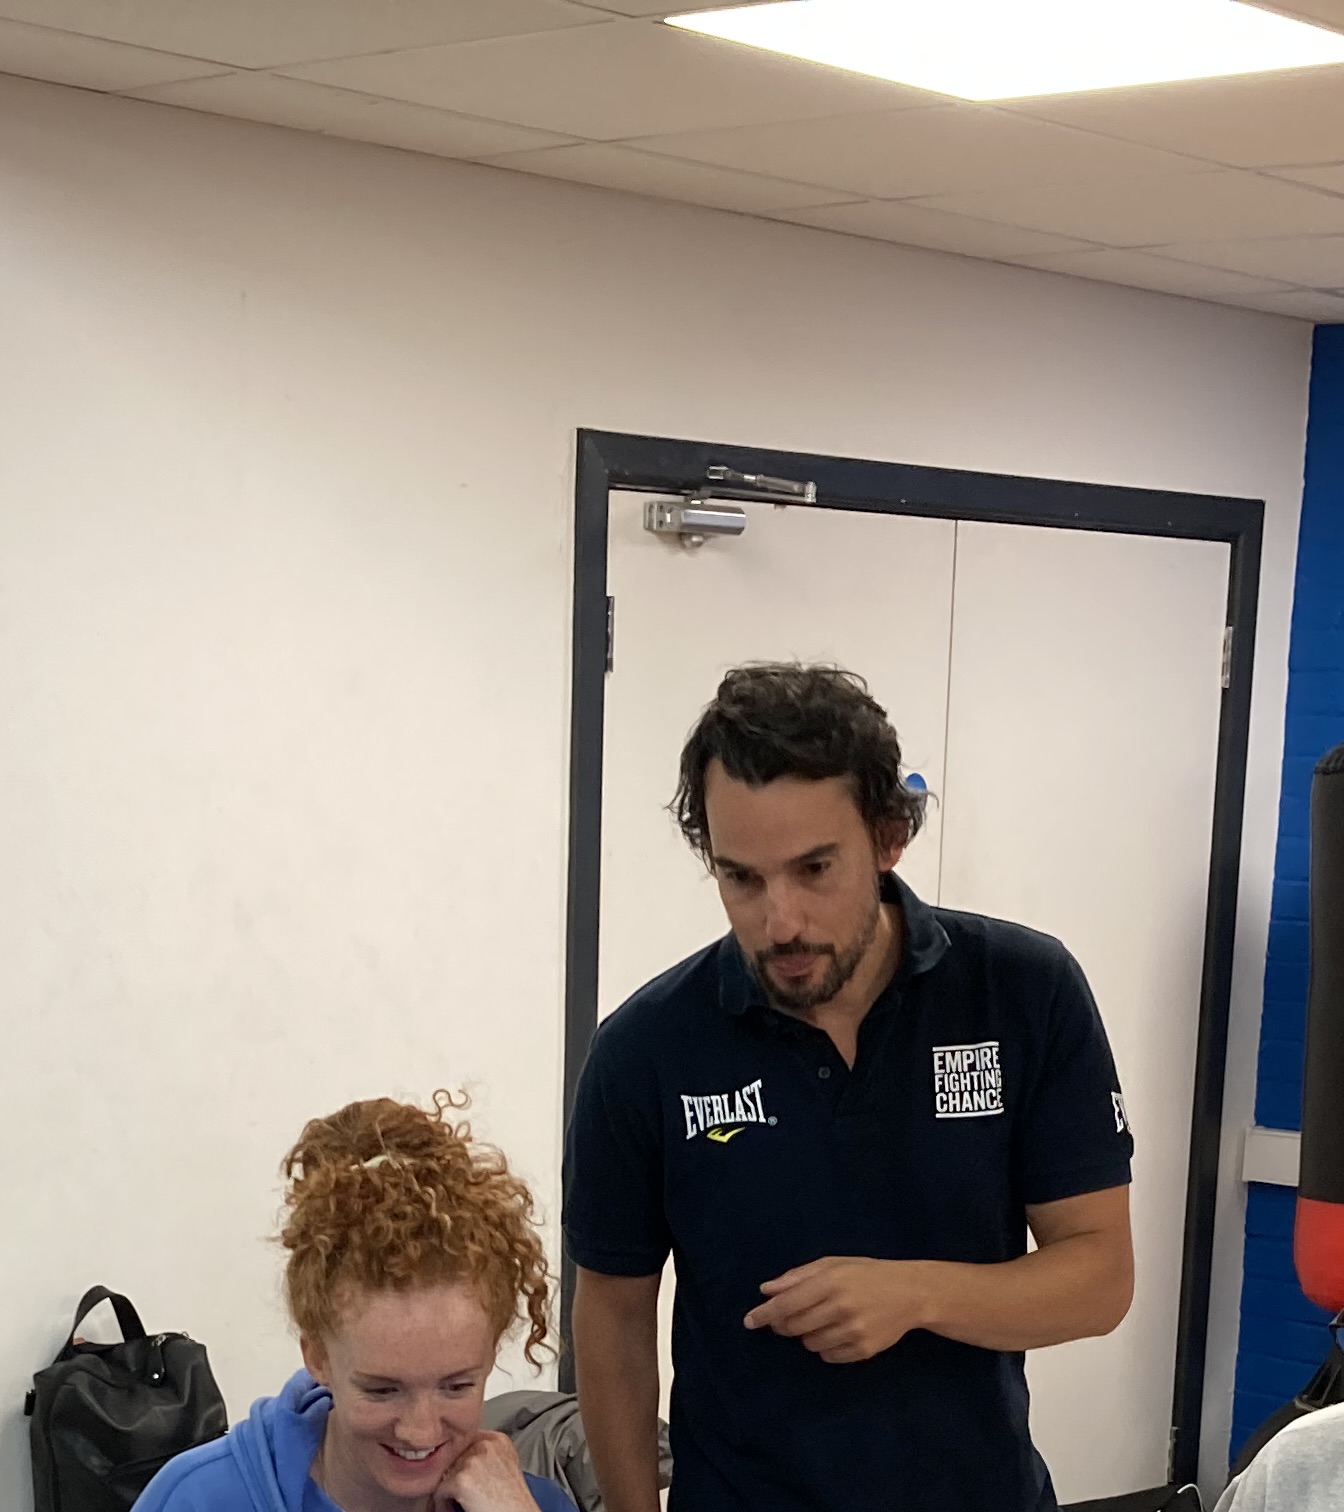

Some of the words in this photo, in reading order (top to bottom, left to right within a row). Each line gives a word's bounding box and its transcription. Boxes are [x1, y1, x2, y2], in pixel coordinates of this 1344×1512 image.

[933, 1047, 1000, 1074] EMPIRE
[934, 1070, 1002, 1094] FIGHTING
[681, 1079, 767, 1140] EVERLAST
[935, 1091, 1003, 1114] CHANCE
